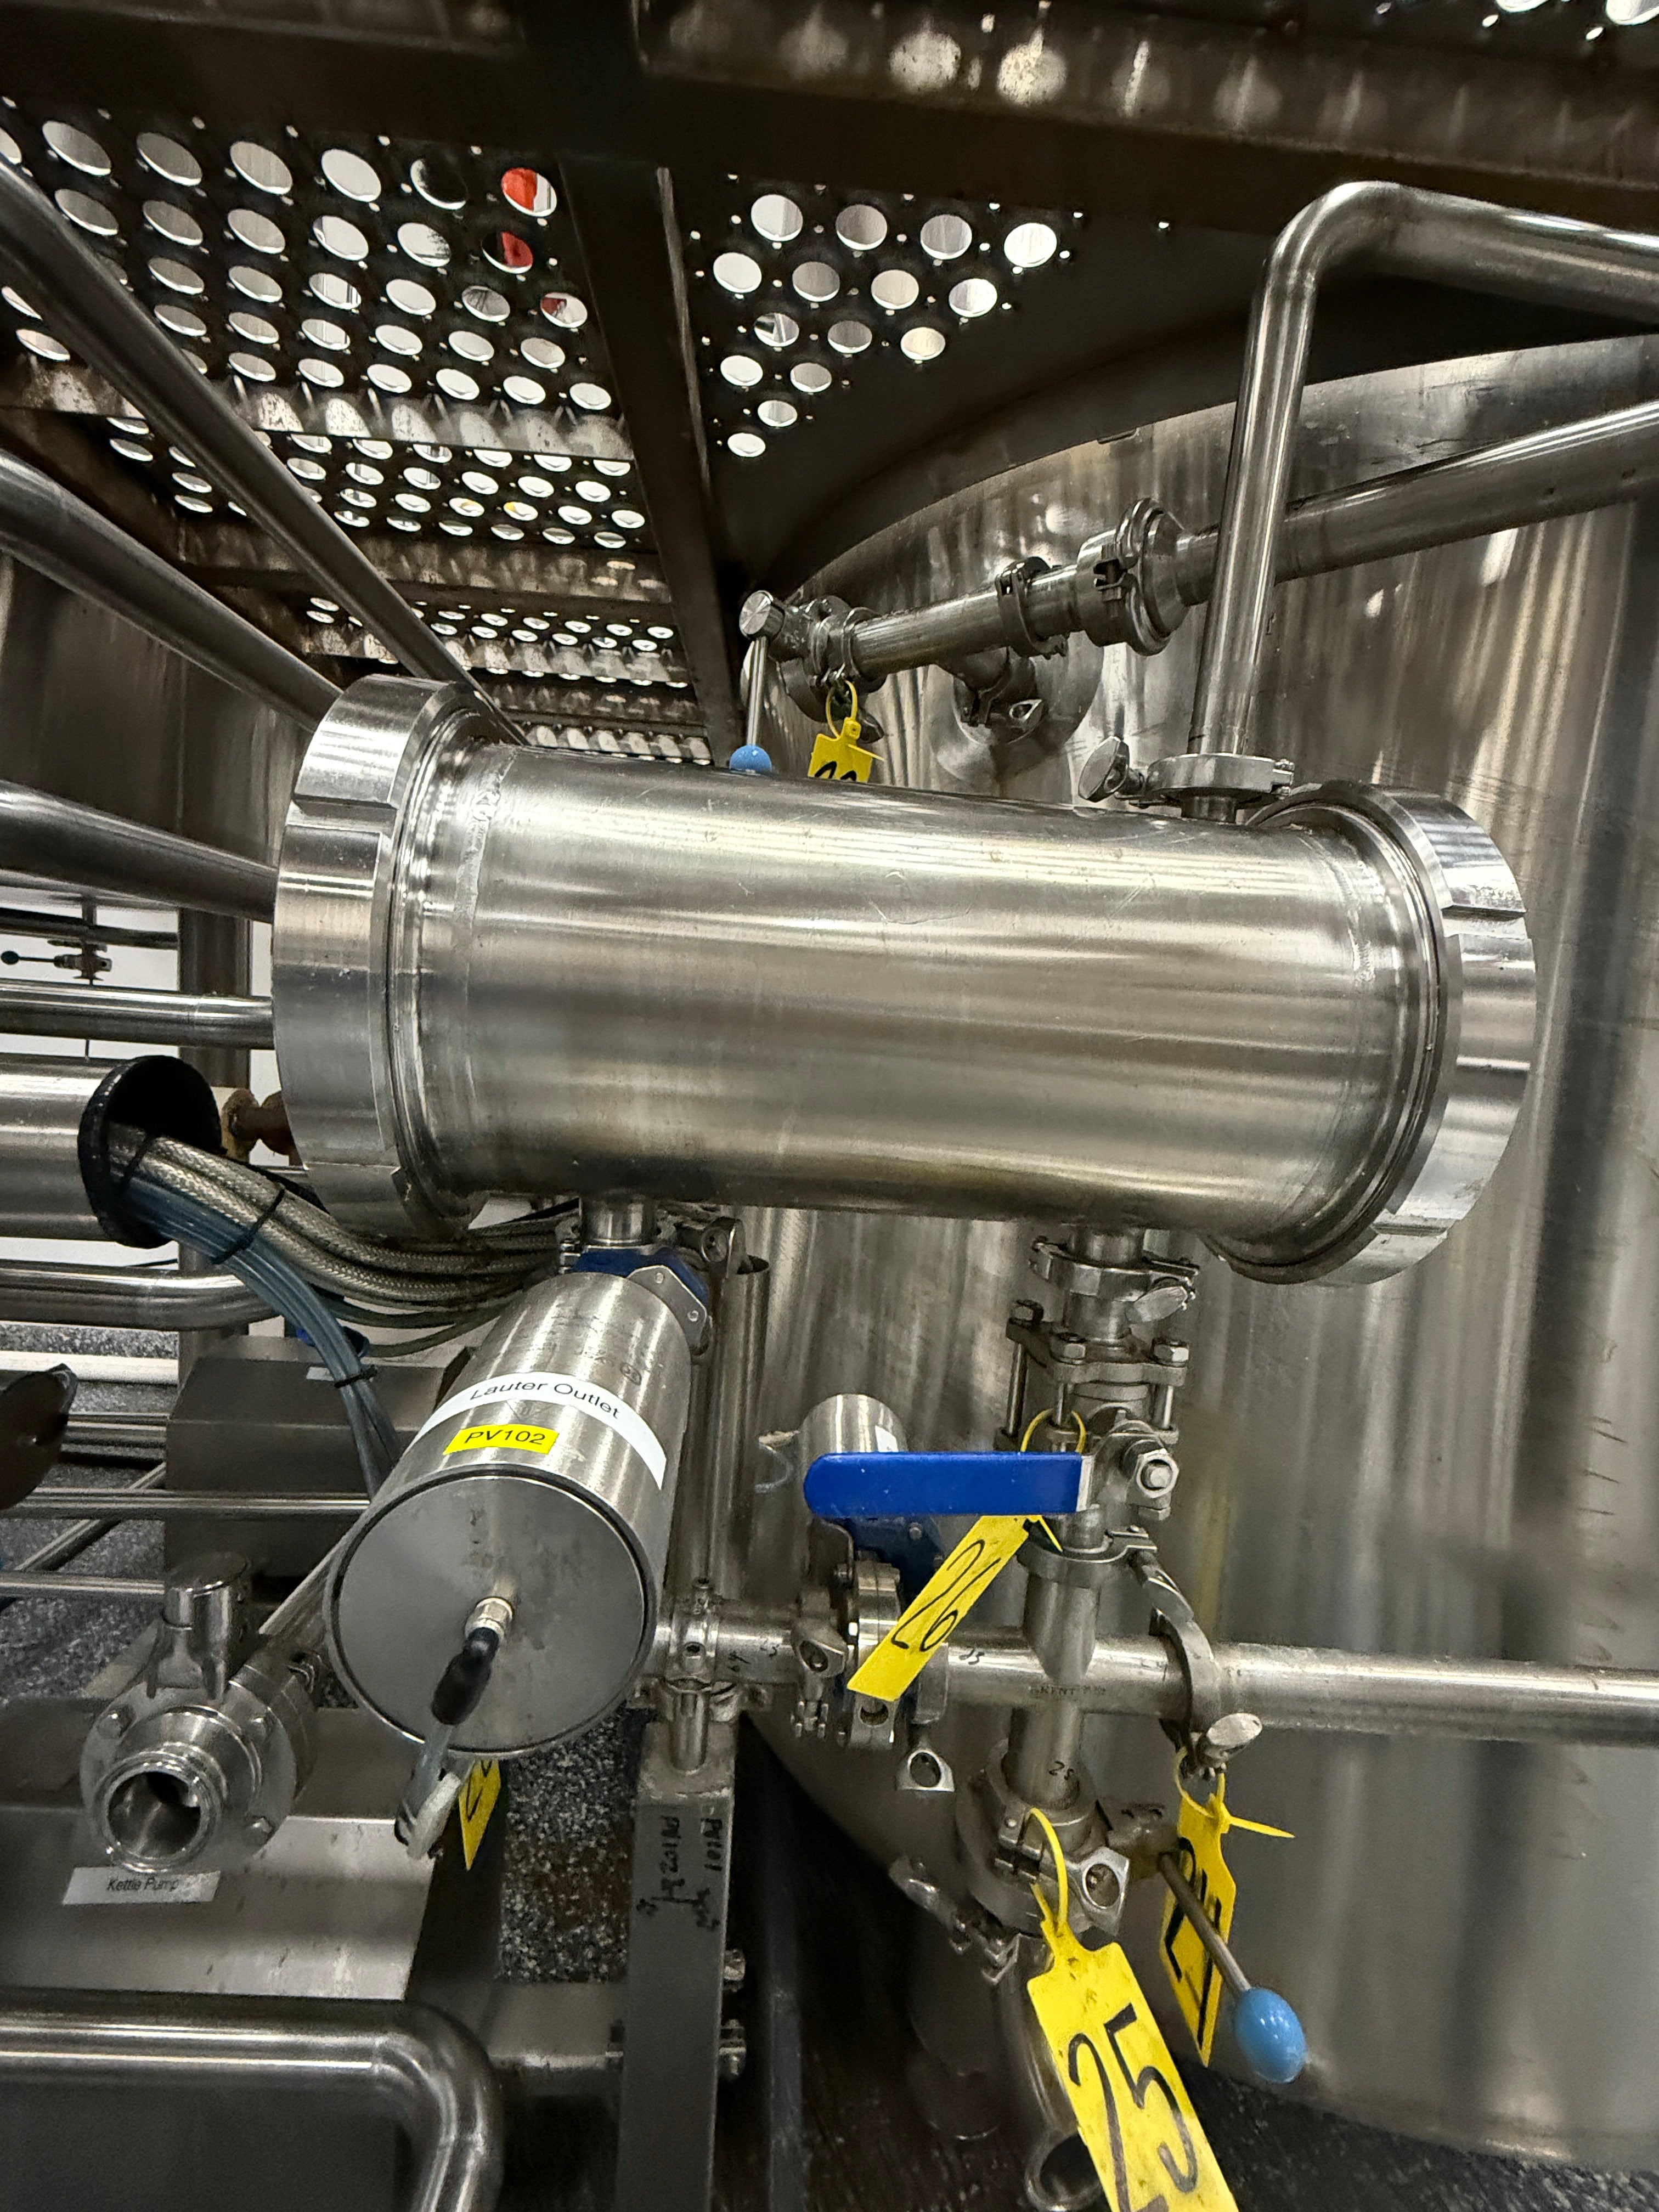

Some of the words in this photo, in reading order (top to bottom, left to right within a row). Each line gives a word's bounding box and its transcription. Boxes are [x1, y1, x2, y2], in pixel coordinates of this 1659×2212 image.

[470, 1380, 549, 1401] Lauter
[554, 1383, 620, 1420] Outlet
[464, 1429, 546, 1446] PV102
[890, 1538, 1002, 1653] 26
[144, 1875, 180, 1892] Pump
[1068, 2002, 1199, 2212] 25
